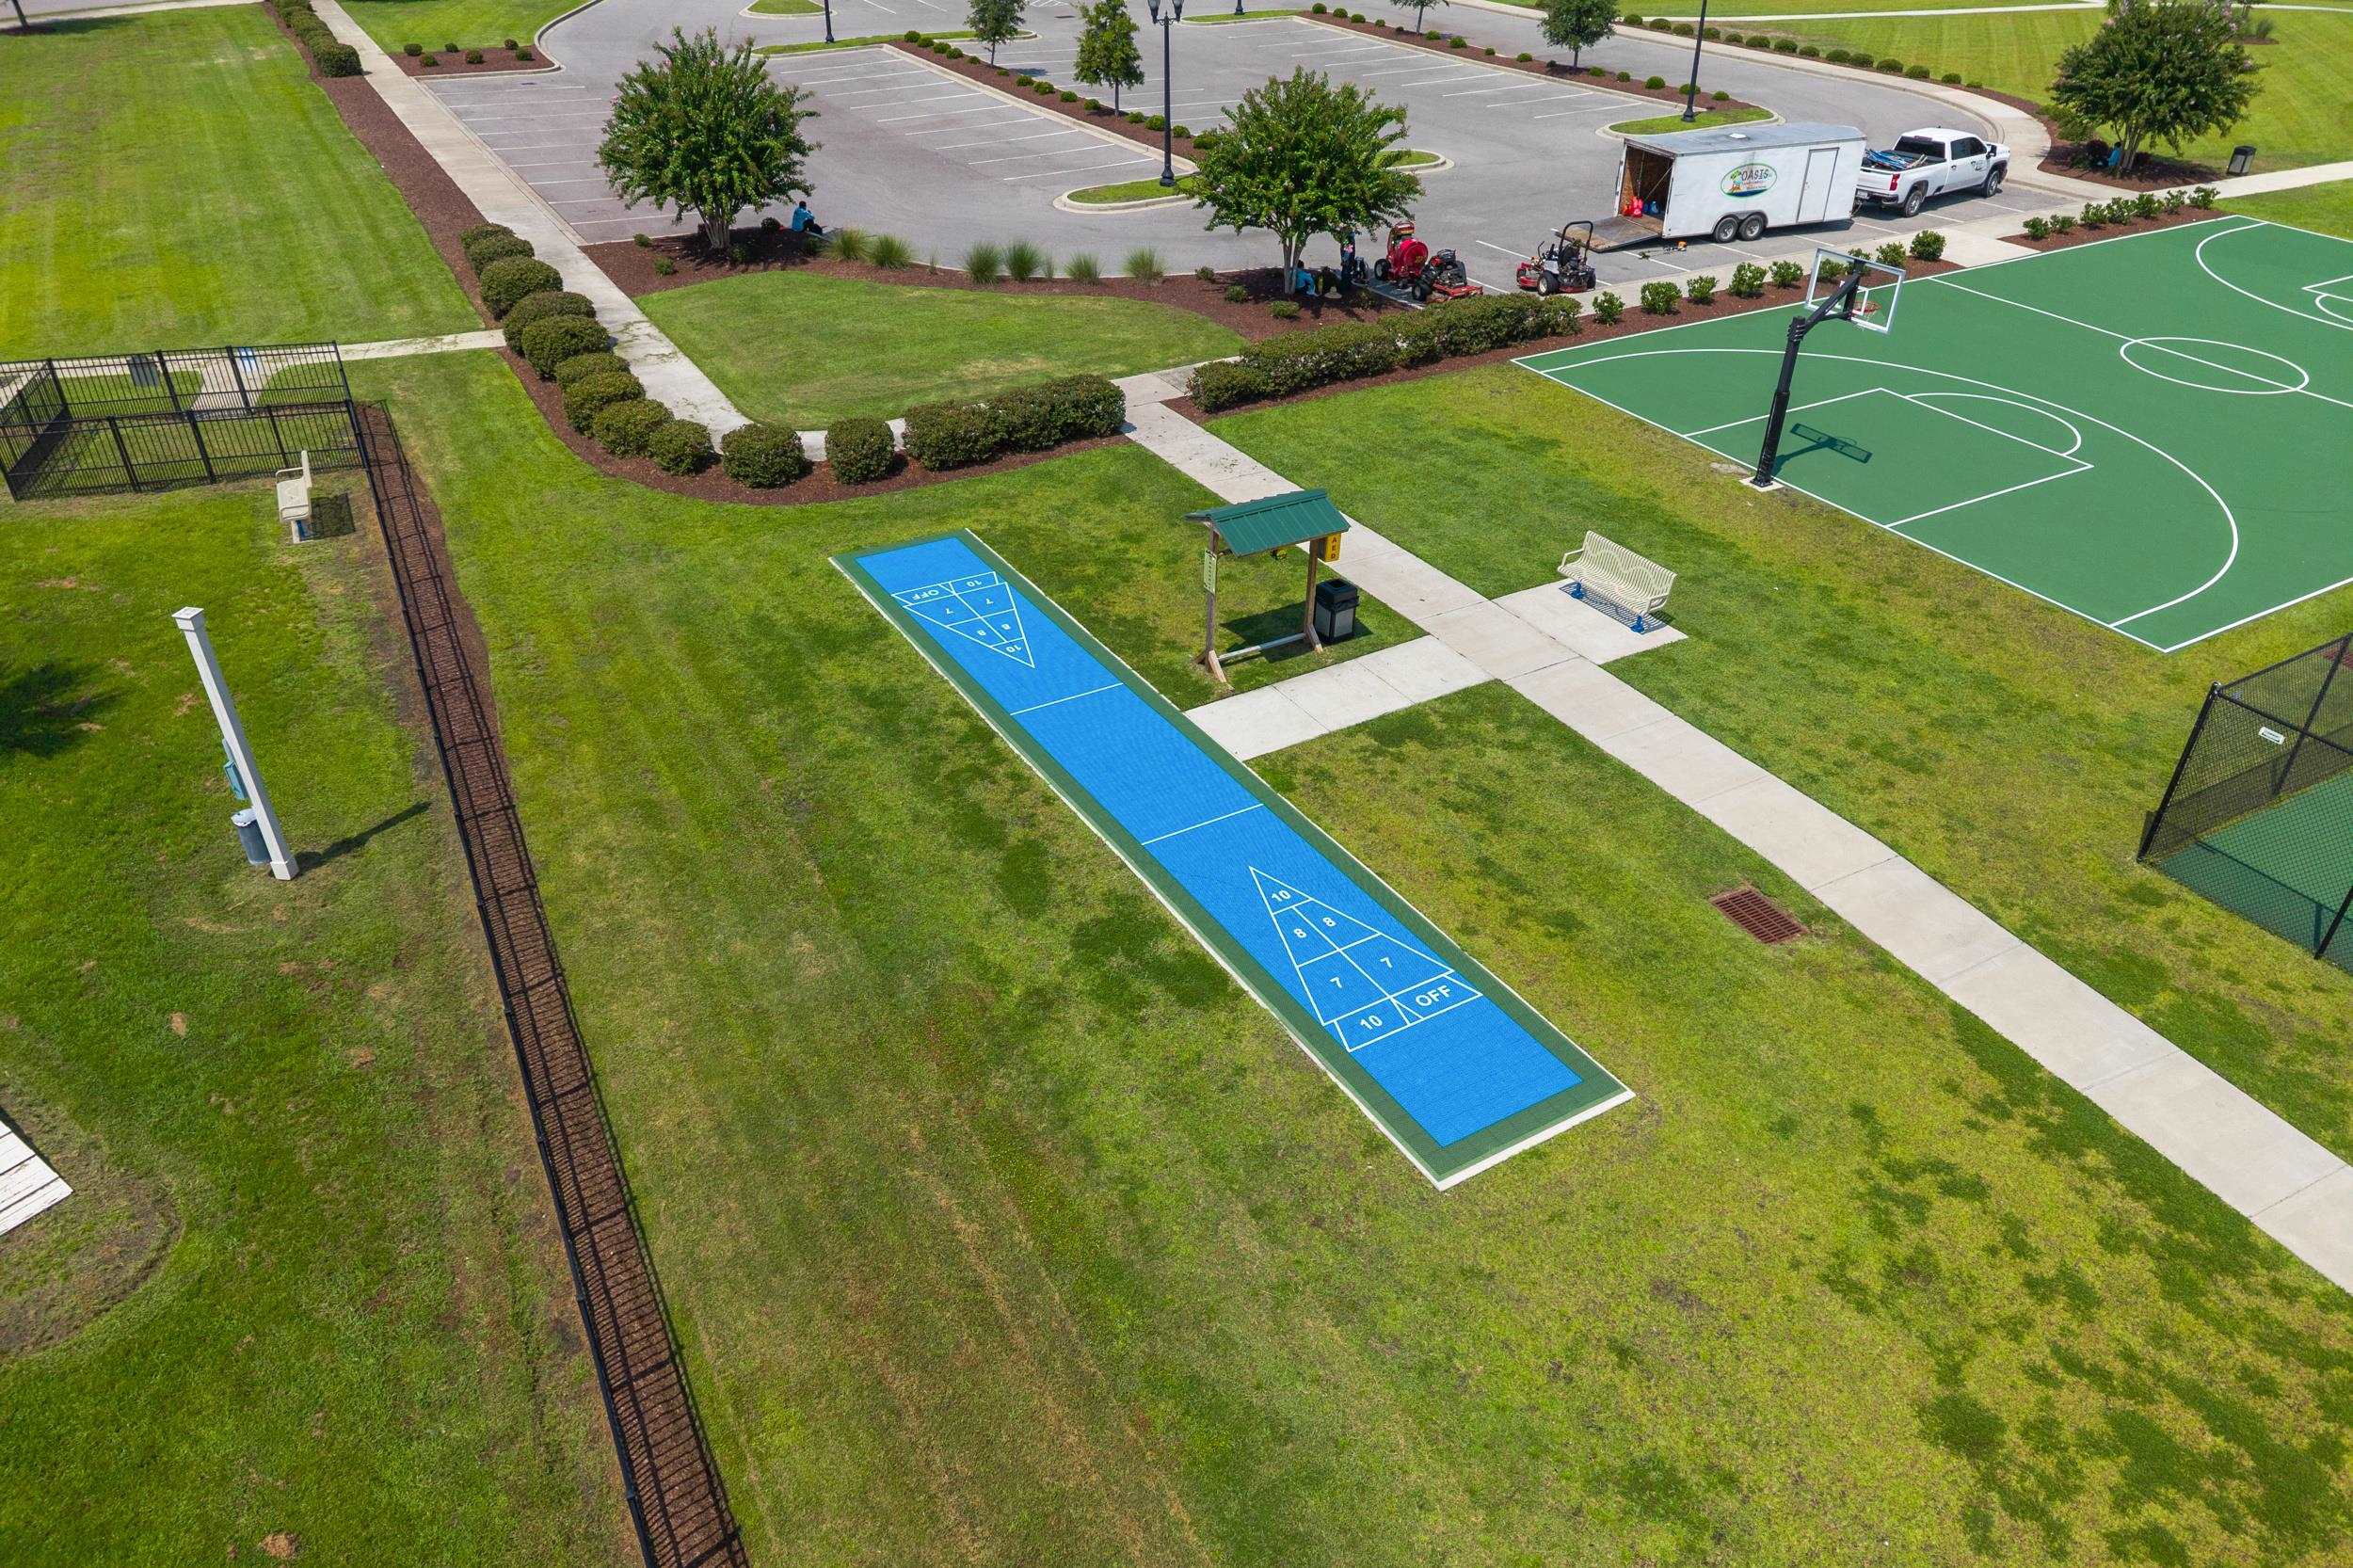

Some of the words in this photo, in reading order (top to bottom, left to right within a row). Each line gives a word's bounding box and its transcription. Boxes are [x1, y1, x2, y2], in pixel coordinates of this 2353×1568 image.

[1741, 168, 1769, 181] OASIS
[966, 579, 983, 587] 10
[912, 589, 939, 600] OFF
[1005, 645, 1022, 653] 10
[1271, 889, 1291, 902] 10
[1293, 928, 1307, 938] 8
[1322, 917, 1337, 927] 8
[1329, 976, 1343, 988] 7
[1380, 956, 1393, 968] 7
[1359, 1015, 1383, 1031] 10
[1415, 984, 1451, 1007] OFF
